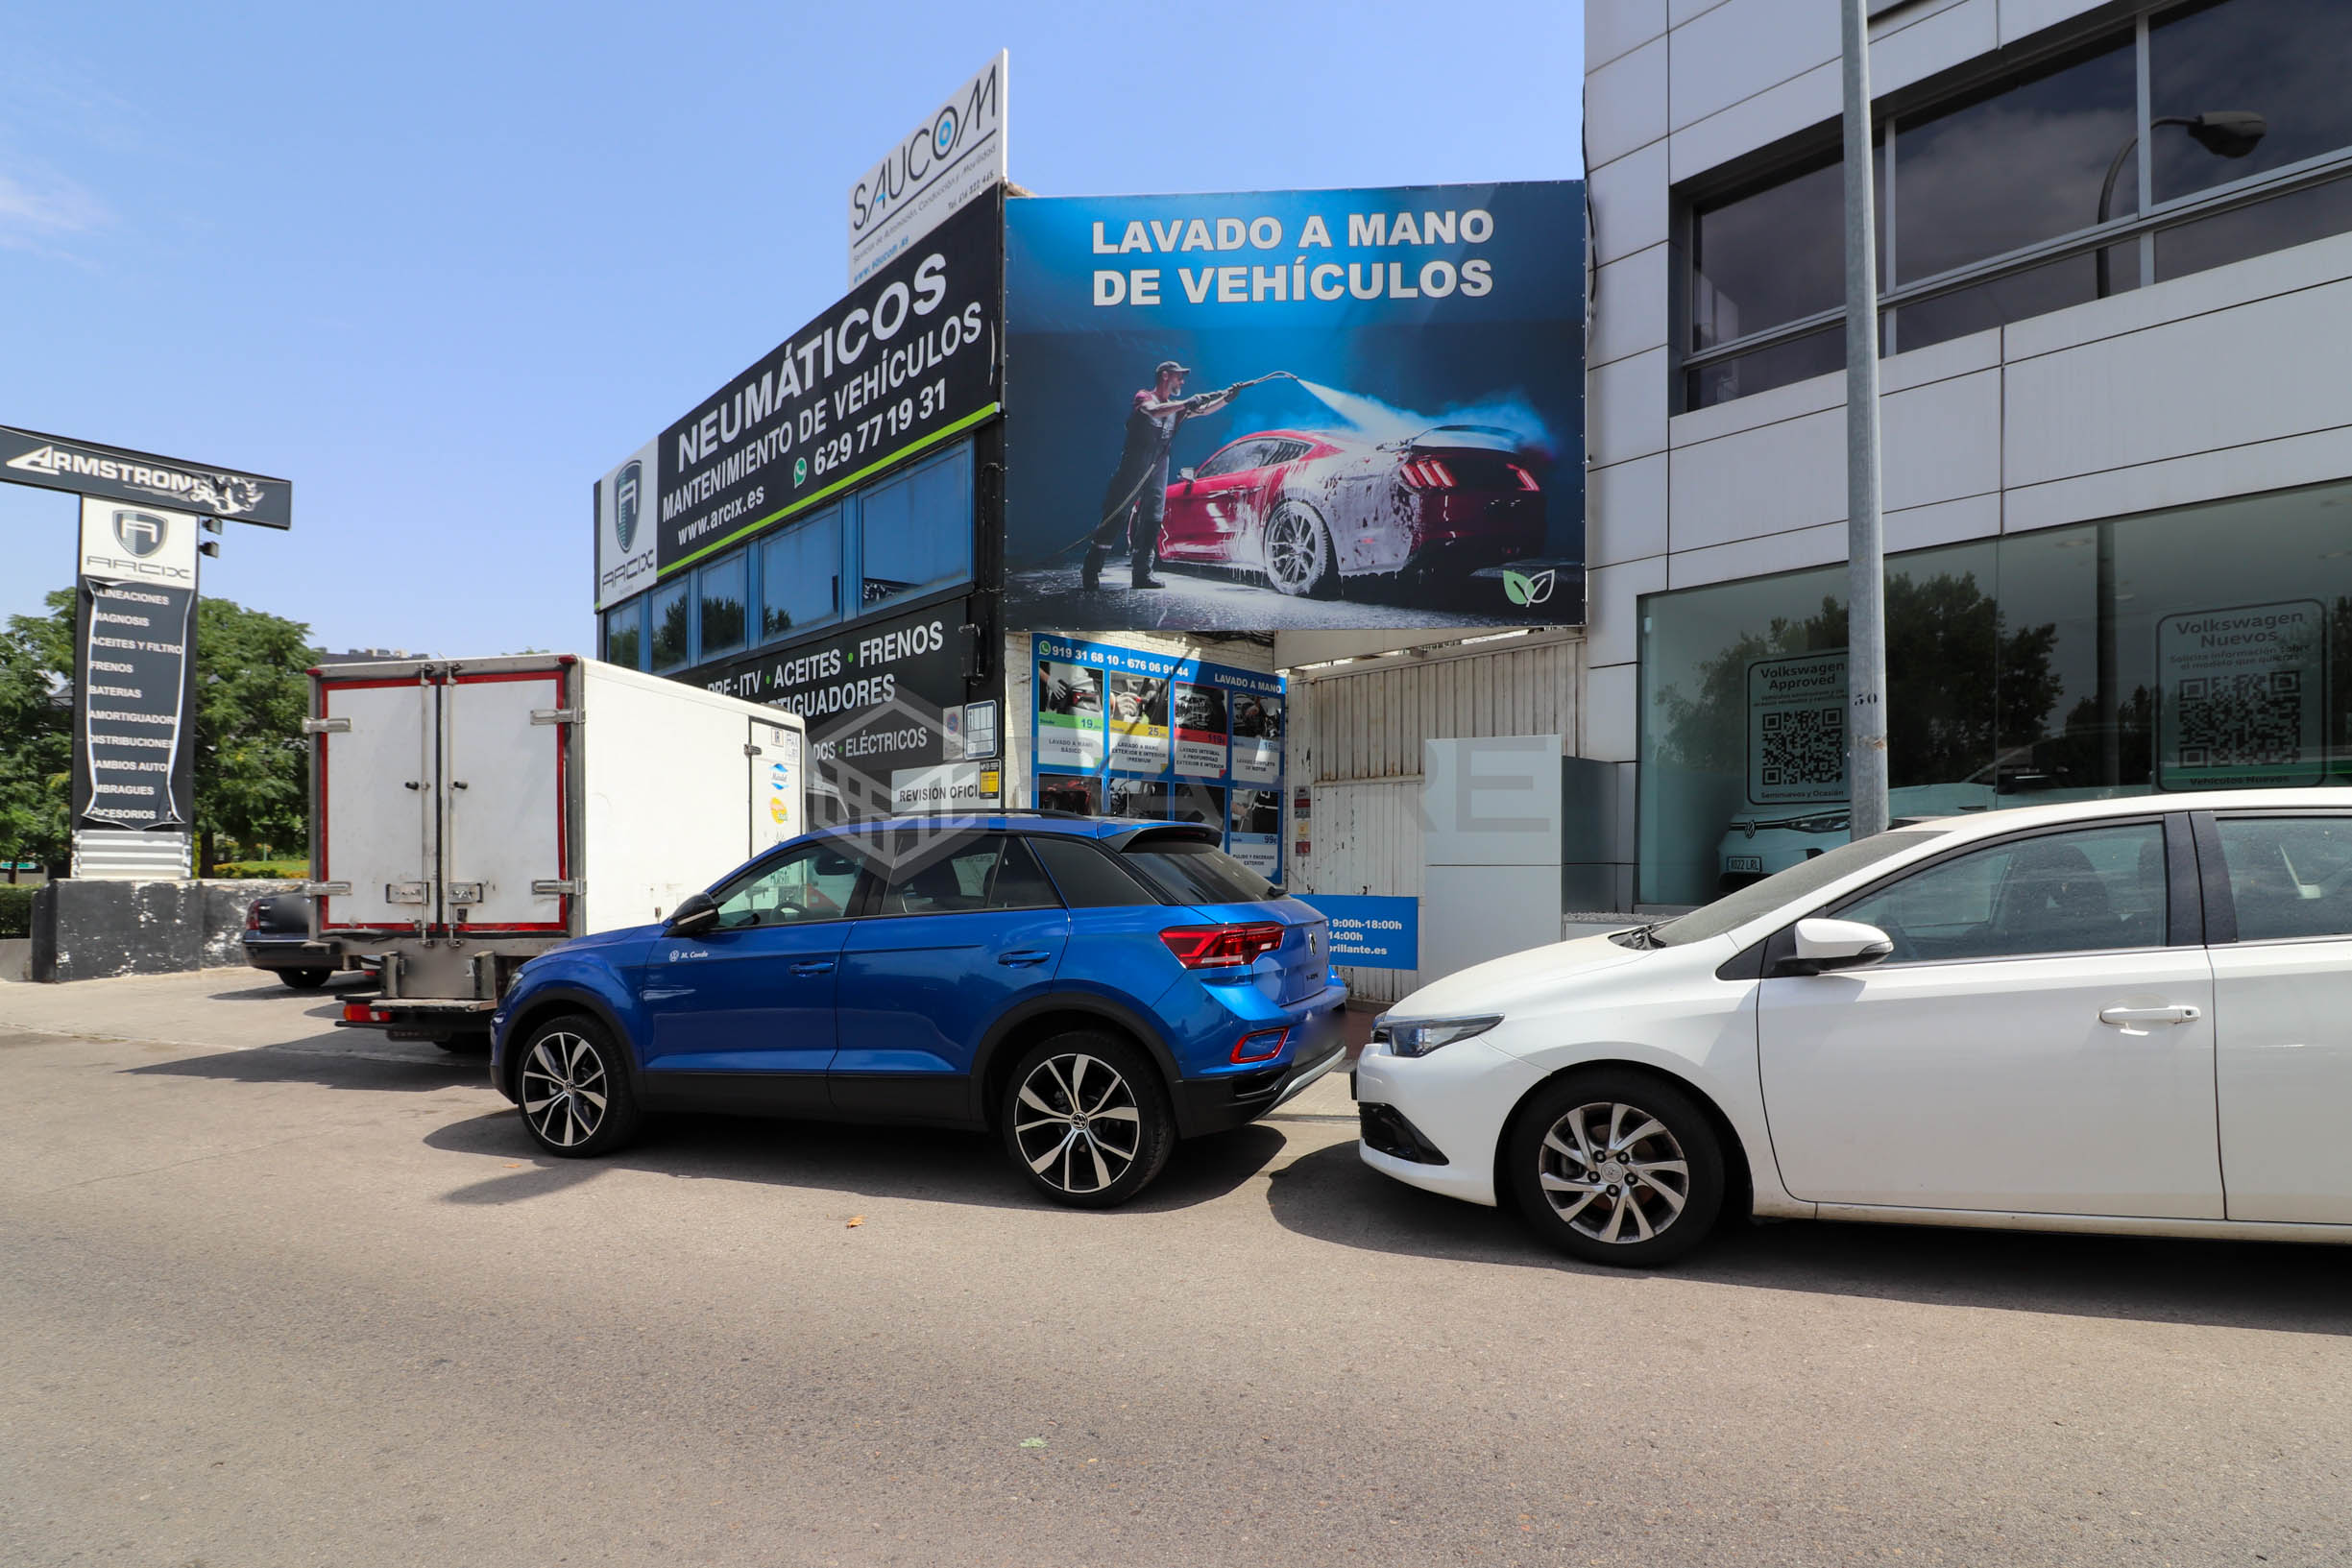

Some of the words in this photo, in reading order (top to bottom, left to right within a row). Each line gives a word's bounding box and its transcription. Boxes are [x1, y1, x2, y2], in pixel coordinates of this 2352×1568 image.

[853, 63, 997, 230] SAUCOM
[1092, 216, 1283, 254] LAVADO
[1297, 214, 1333, 248] A
[1347, 209, 1495, 247] MANO
[1092, 268, 1161, 306] DE
[1176, 255, 1494, 304] VEHÍCULOS
[678, 253, 947, 472] NEUMÁTICOS
[663, 422, 792, 522] MANTENIMIENTO
[799, 402, 826, 445] DE
[835, 302, 982, 422] VEHÍCULOS
[813, 432, 853, 477] 629
[919, 378, 946, 421] 31
[677, 483, 765, 546] www.arcix.es
[86, 555, 191, 580] ARCIX
[602, 548, 654, 592] ARCIX
[96, 589, 169, 605] LINEACIONES
[96, 612, 150, 627] IAGNOSIS
[2176, 613, 2304, 635] Volkswagen
[90, 636, 135, 649] ACEITES
[136, 640, 146, 650] Y
[2200, 631, 2279, 648] Nuevos
[774, 648, 841, 688] ACEITES
[860, 620, 944, 668] FRENOS
[1052, 646, 1072, 659] 919
[1075, 649, 1088, 661] 31
[1090, 652, 1104, 664] 68
[1106, 654, 1120, 666] 10
[1128, 659, 1147, 671] 676
[1149, 663, 1161, 674] 06
[1176, 666, 1189, 677] 44
[89, 660, 133, 674] FRENOS
[1760, 662, 1845, 679] Volkswagen
[89, 685, 142, 698] BATERIAS
[1214, 673, 1249, 688] LAVADO
[1249, 680, 1257, 688] A
[1258, 681, 1282, 694] MANO
[1769, 673, 1835, 691] Approved
[1080, 718, 1093, 730] 19
[1148, 727, 1160, 736] 25
[845, 727, 928, 758] ELÉCTRICOS
[94, 760, 136, 770] AMBIOS
[138, 761, 169, 772] AUTO
[899, 783, 946, 803] REVISIÓN
[950, 784, 980, 800] OFICI
[1332, 919, 1402, 930] 9:00h-18:00h
[690, 950, 709, 959] Conde
